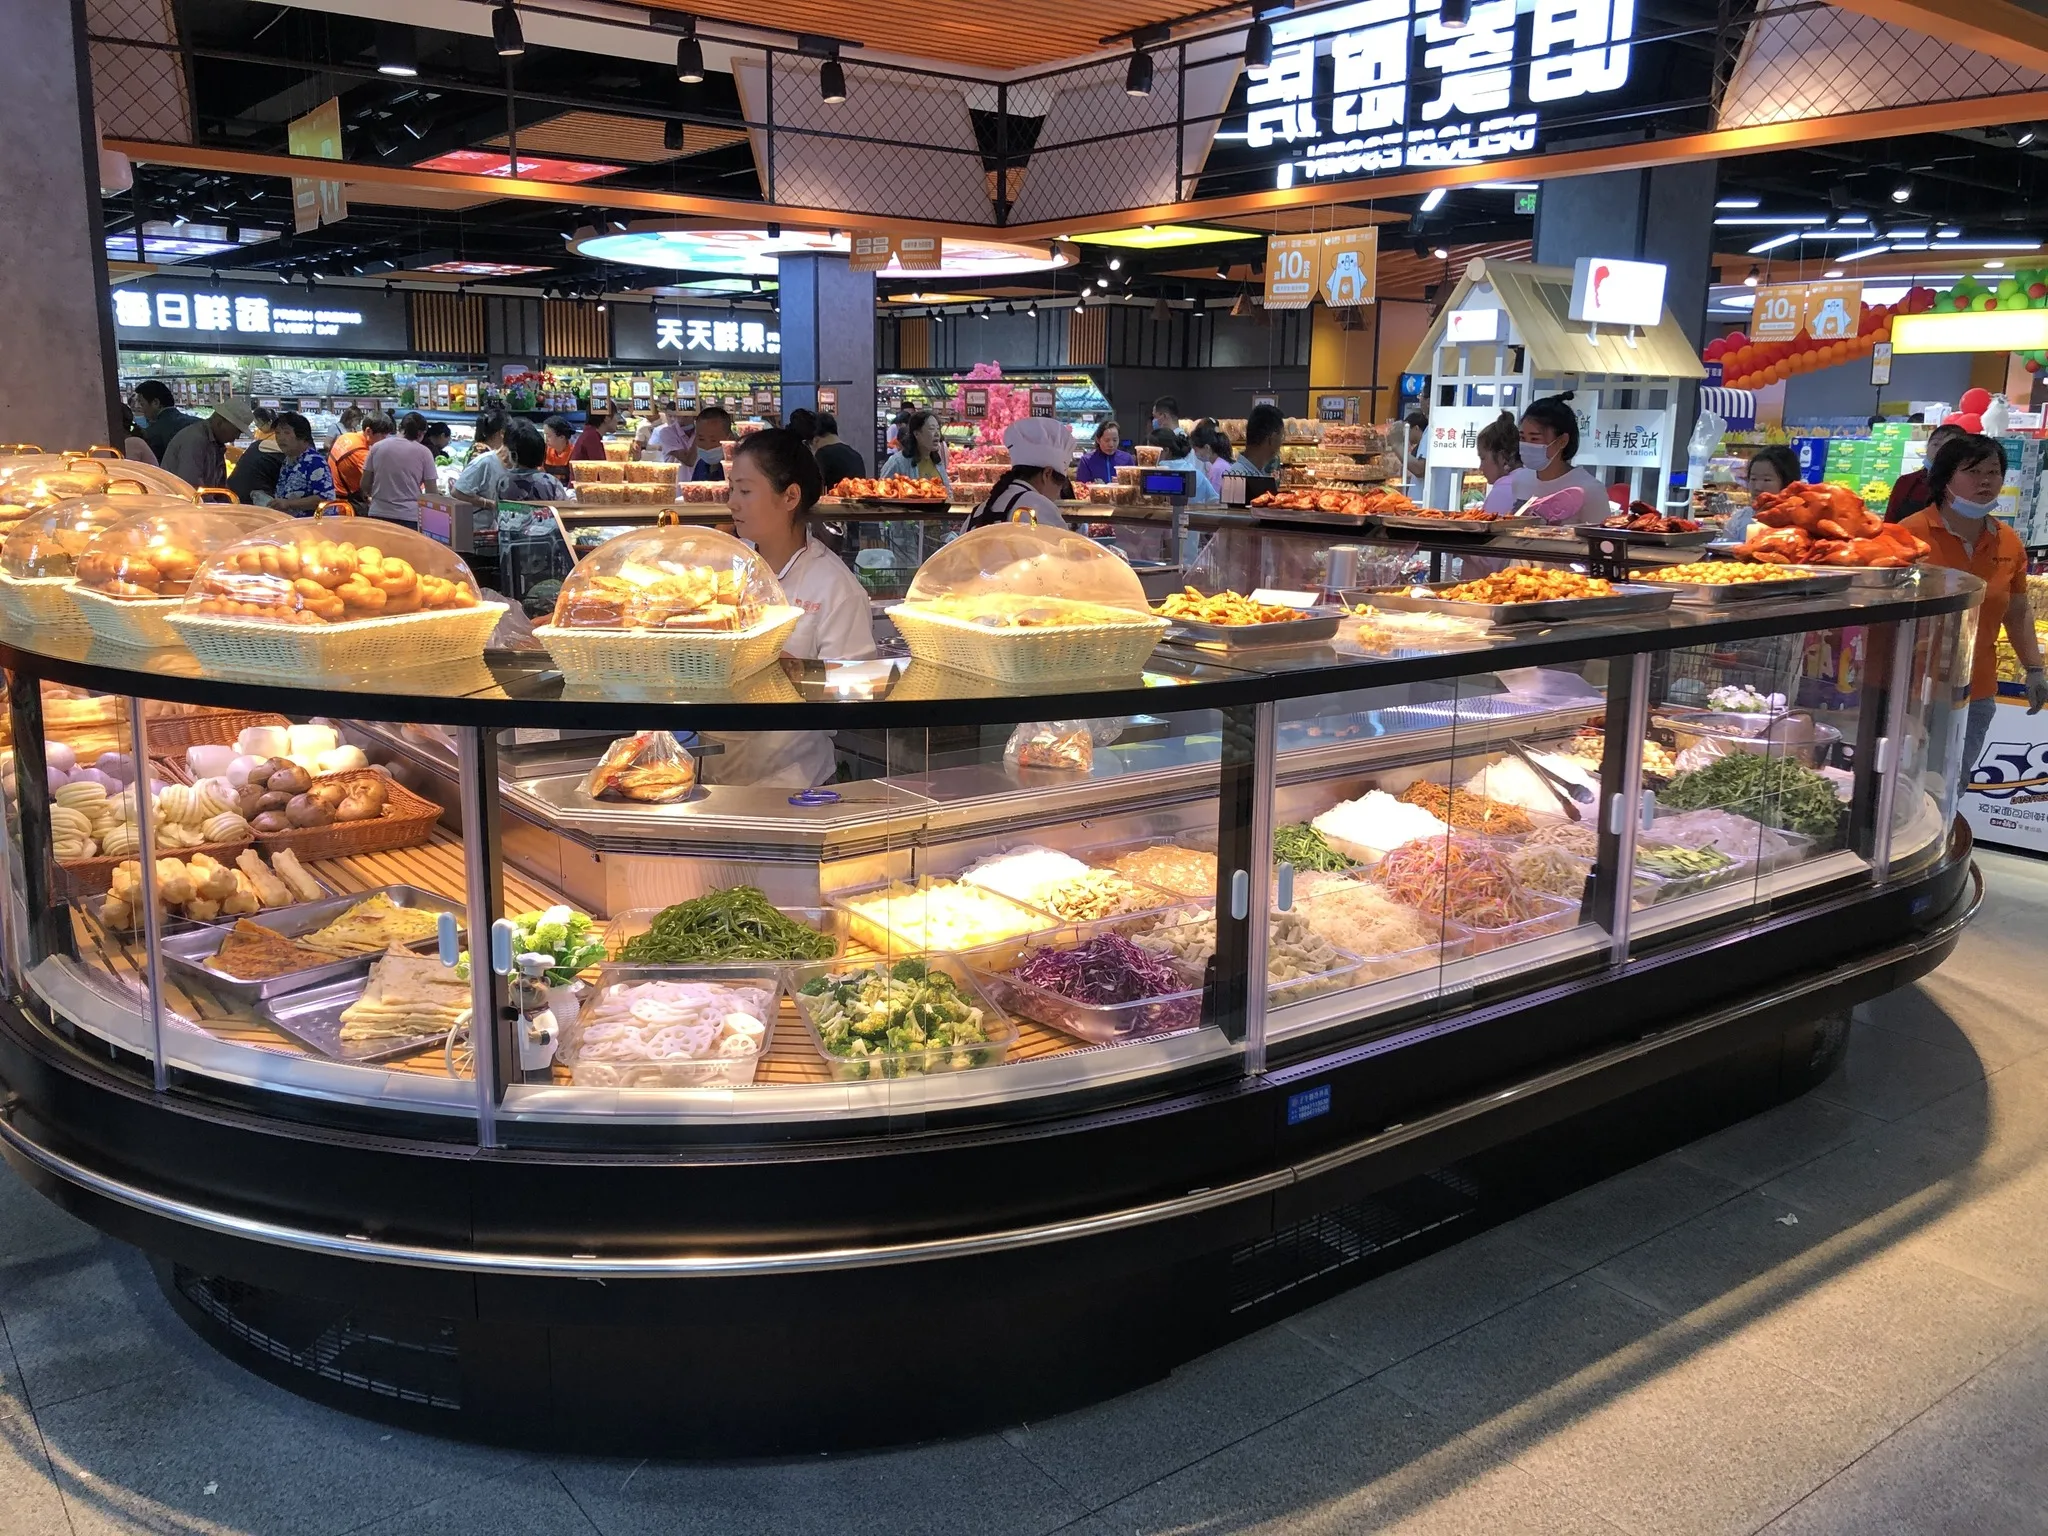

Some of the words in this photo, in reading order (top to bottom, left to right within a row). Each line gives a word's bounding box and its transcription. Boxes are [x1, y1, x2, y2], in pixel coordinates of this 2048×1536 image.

[656, 318, 765, 353] 天天鲜果
[1434, 427, 1457, 441] 零食
[1605, 423, 1659, 456] 情报站
[1433, 440, 1457, 449] Snack
[1625, 449, 1654, 457] station
